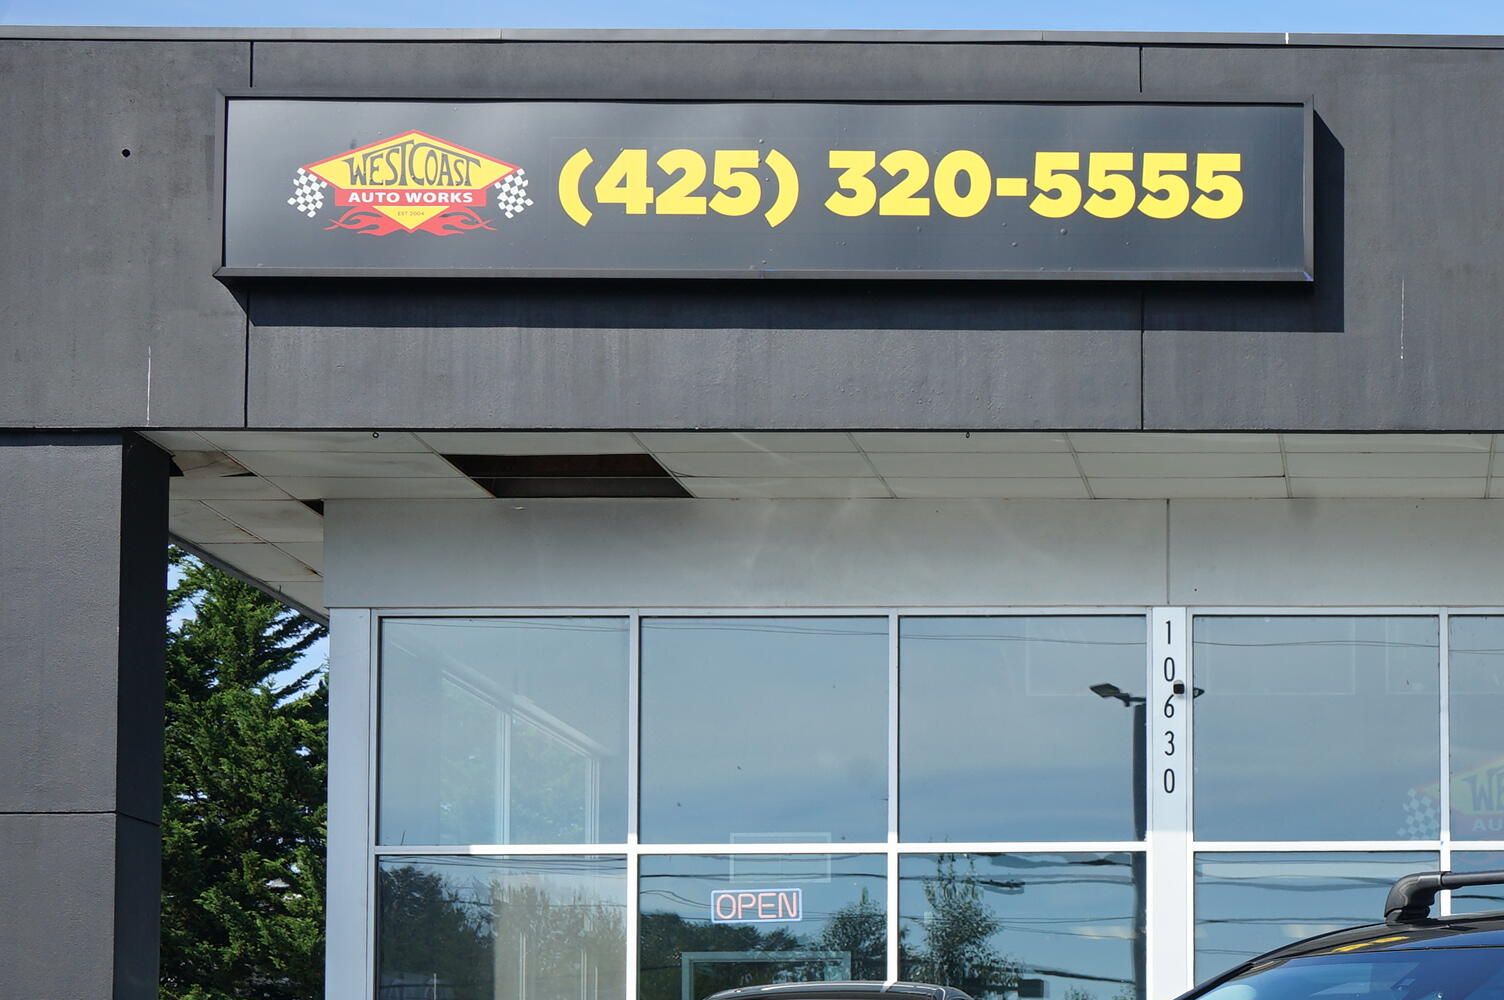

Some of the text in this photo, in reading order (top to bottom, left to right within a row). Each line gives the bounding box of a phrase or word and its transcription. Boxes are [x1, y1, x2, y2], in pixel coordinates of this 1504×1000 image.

[348, 192, 473, 203] AUTO WORKS
[558, 148, 1244, 228] (425) 320-5555
[1163, 620, 1175, 793] 10630
[716, 892, 797, 919] OPEN
